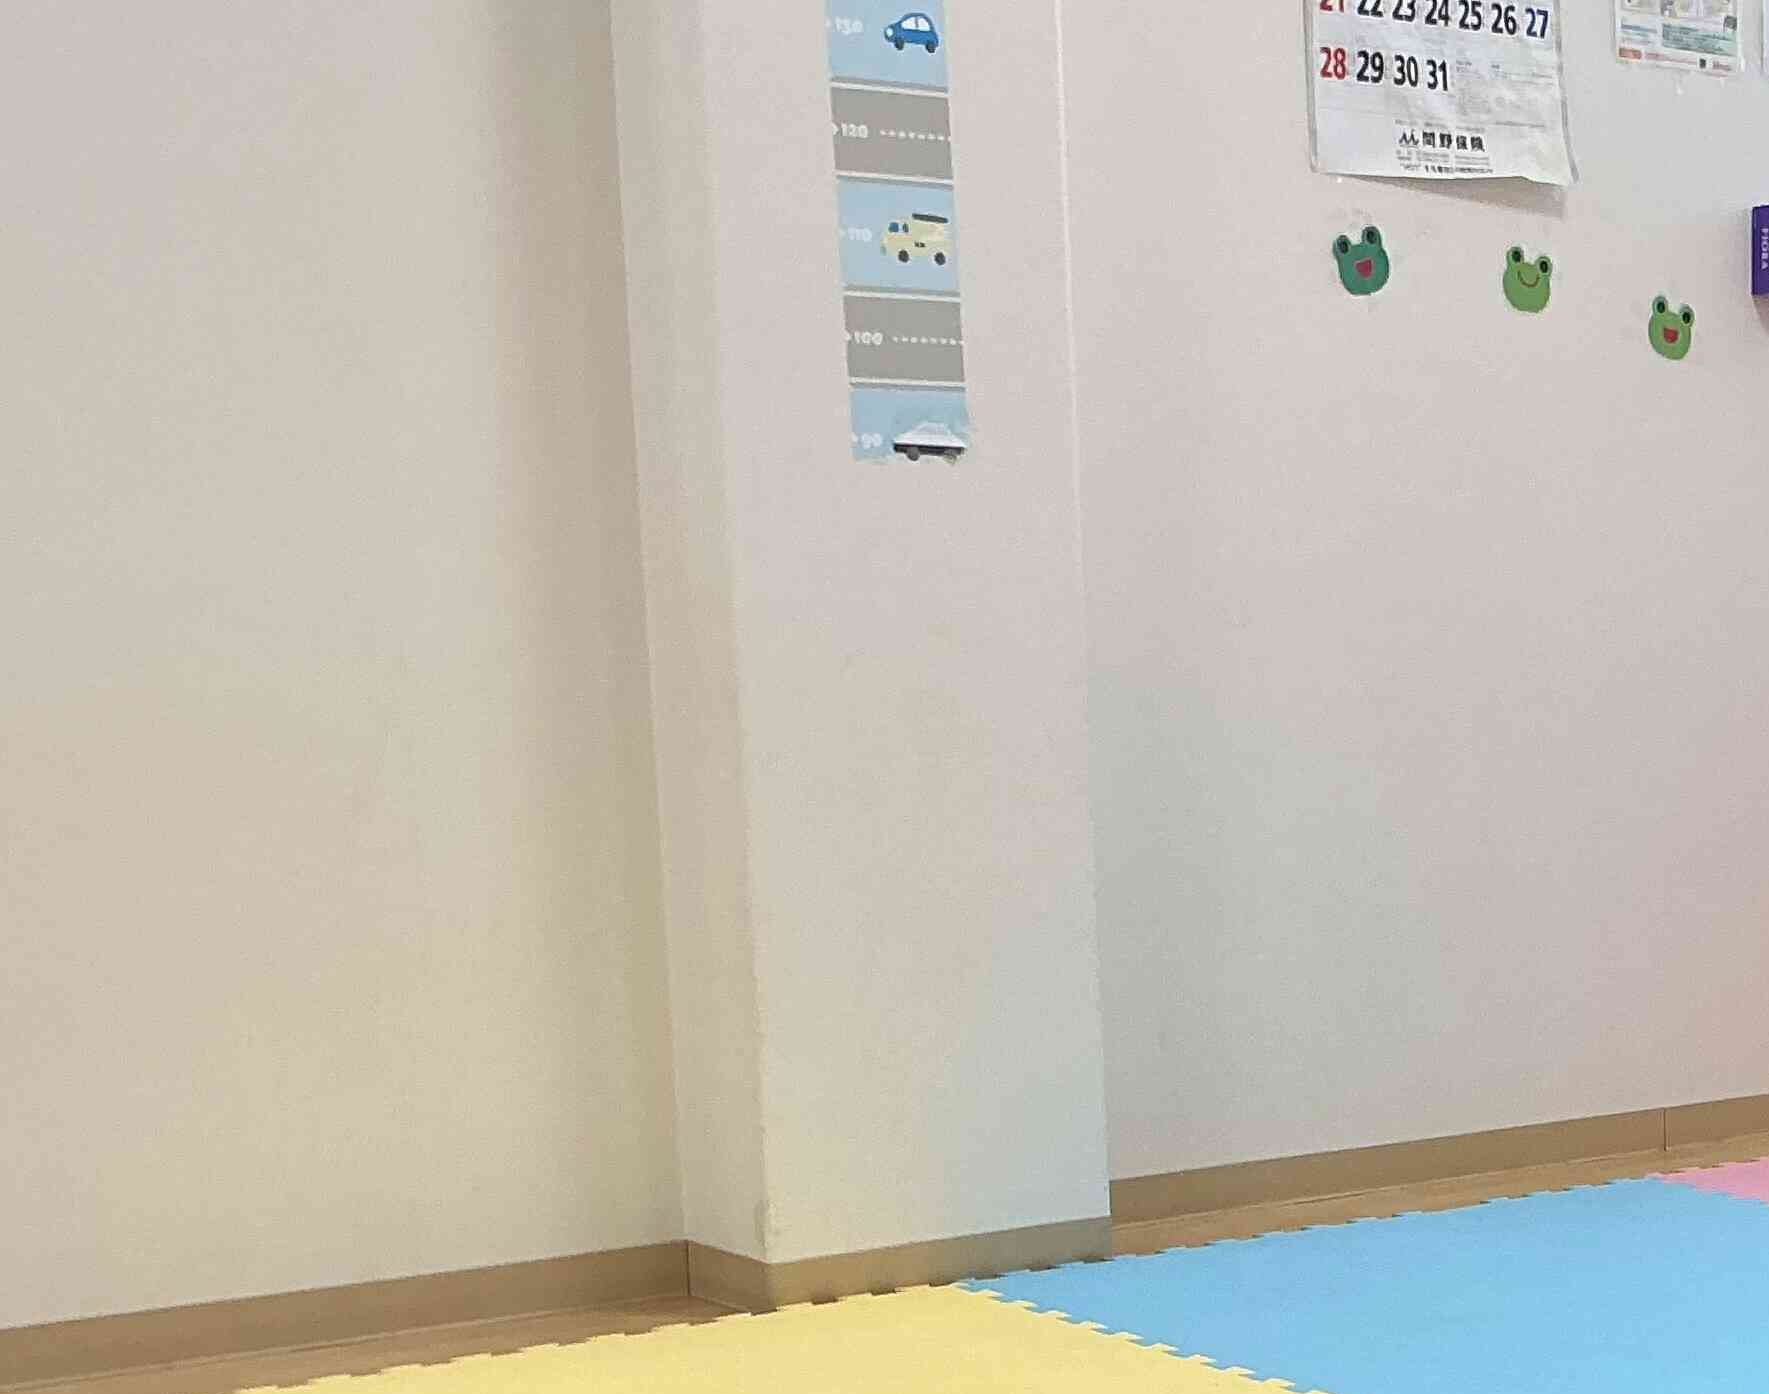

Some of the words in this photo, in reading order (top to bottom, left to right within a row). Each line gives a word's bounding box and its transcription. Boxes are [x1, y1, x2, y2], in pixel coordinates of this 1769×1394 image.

[1424, 0, 1450, 27] 24
[1459, 0, 1482, 31] 25
[1491, 2, 1517, 35] 26
[1525, 7, 1549, 39] 27
[1320, 47, 1347, 80] 28
[1356, 50, 1384, 84] 29
[1393, 55, 1419, 88] 30
[1426, 59, 1448, 91] 31
[841, 123, 869, 138] 120
[854, 331, 884, 346] 100
